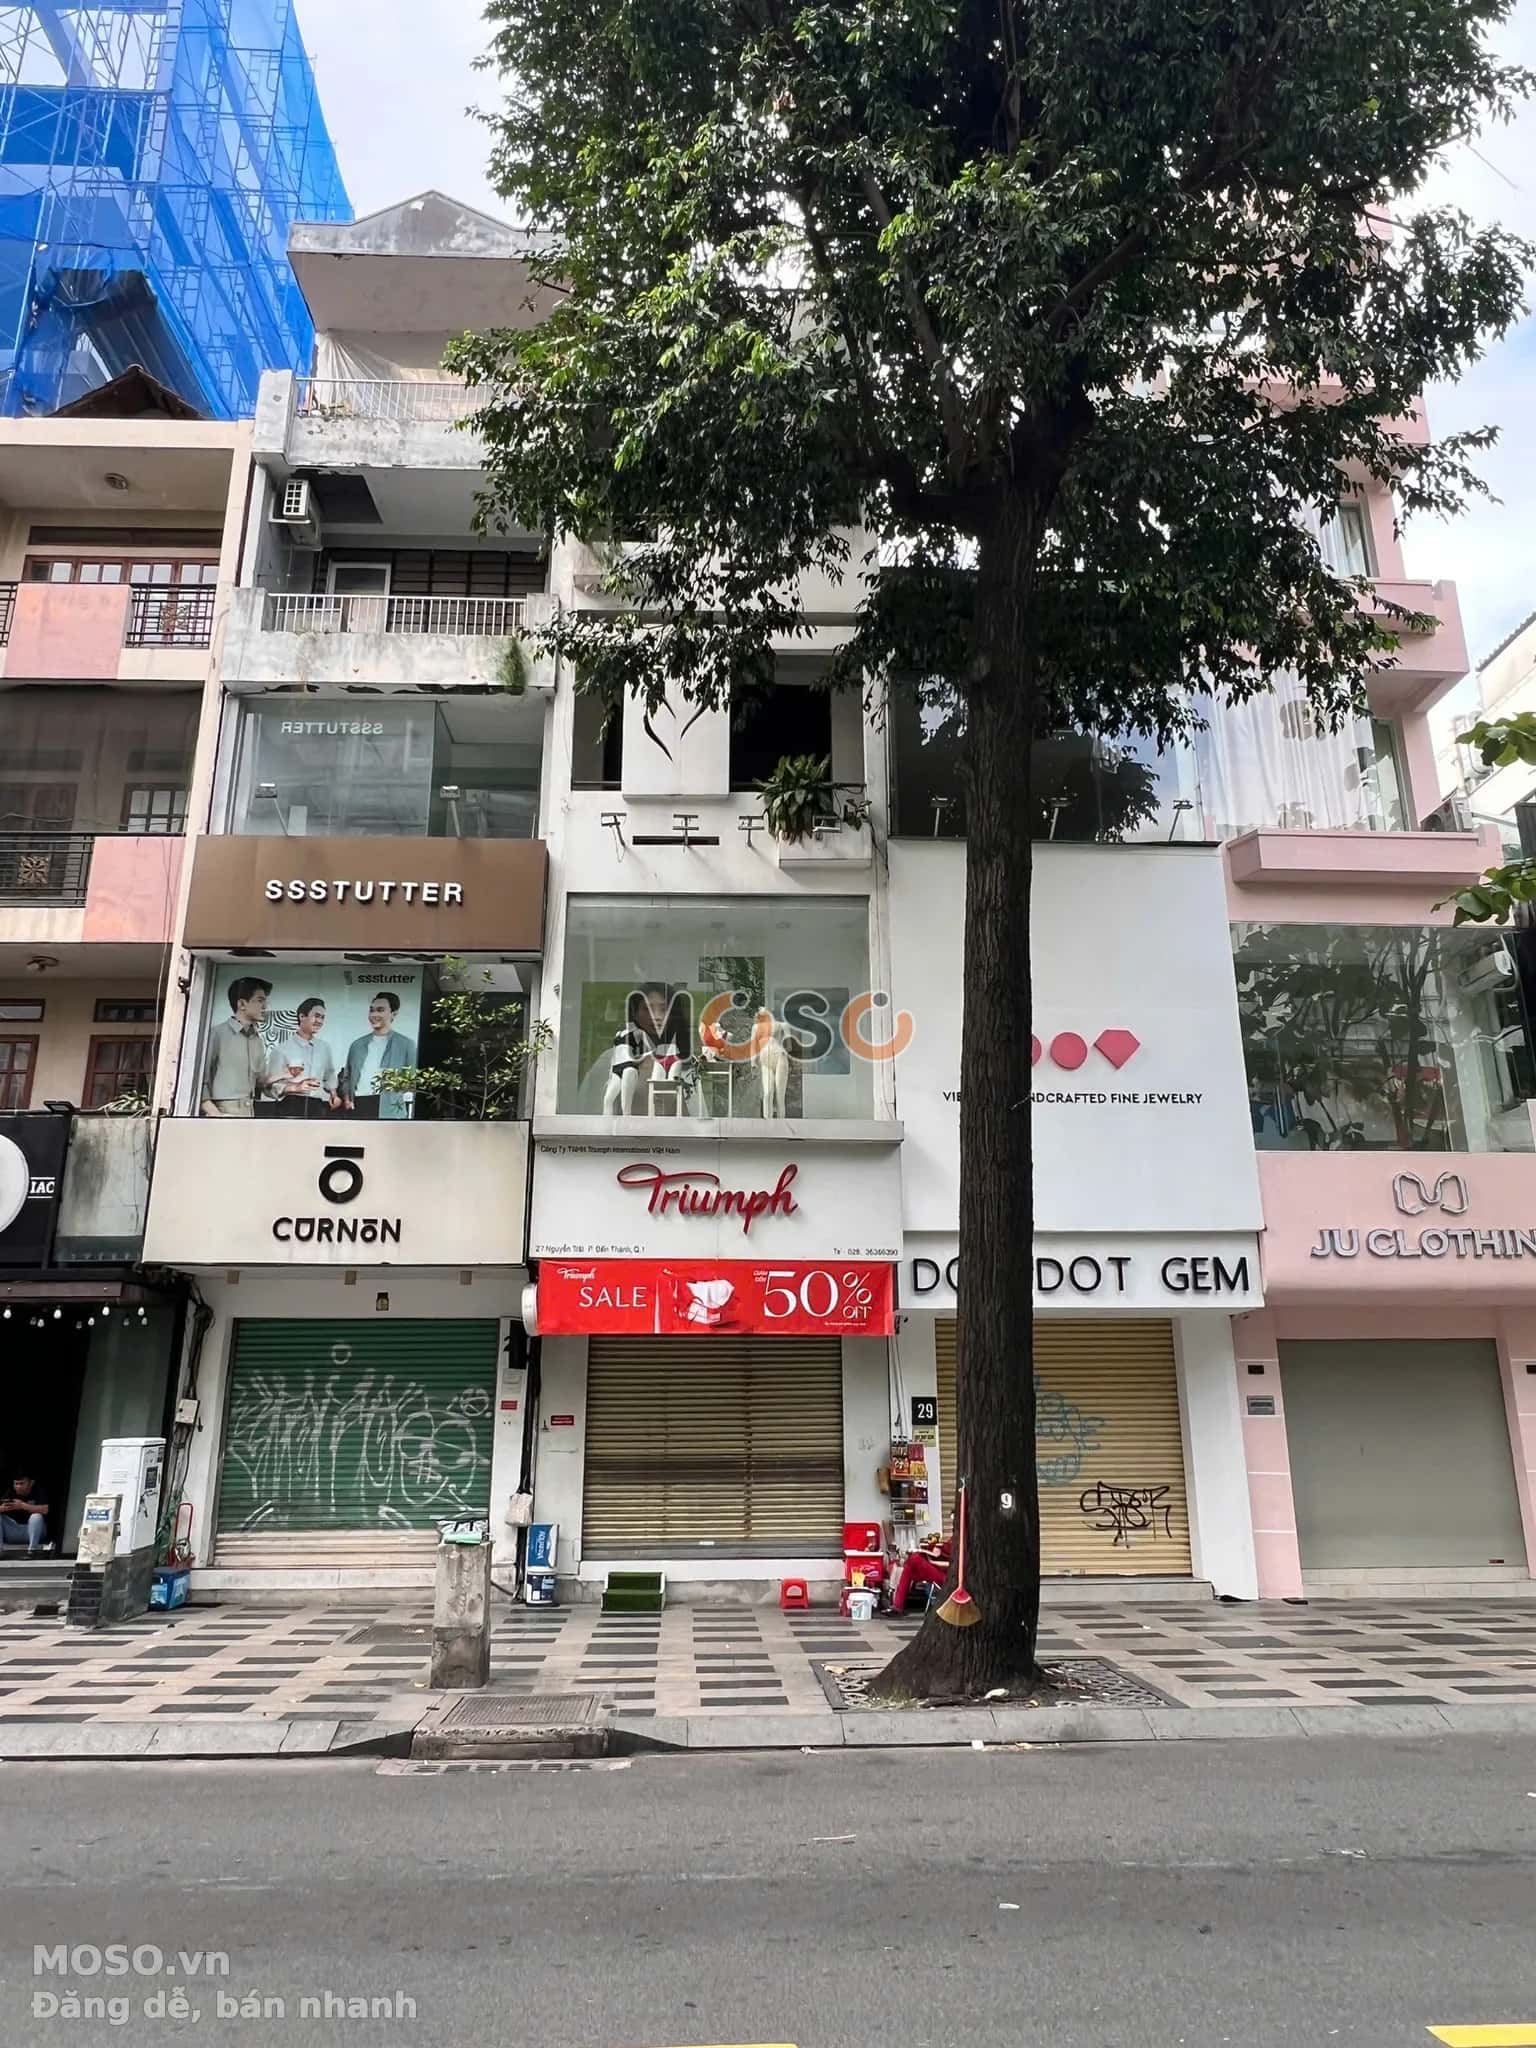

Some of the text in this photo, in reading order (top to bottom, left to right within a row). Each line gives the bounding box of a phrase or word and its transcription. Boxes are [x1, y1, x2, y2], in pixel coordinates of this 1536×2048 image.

[265, 879, 463, 904] SSSTUTTER
[357, 974, 415, 985] ssstutter
[1110, 1093, 1140, 1104] FINE
[1143, 1093, 1203, 1105] JEWELRY
[617, 1164, 799, 1235] Triumph
[1311, 1228, 1360, 1258] JU
[1036, 1256, 1131, 1293] DOT
[1161, 1256, 1249, 1293] GEM
[579, 1287, 647, 1308] SALE
[763, 1270, 872, 1318] 50%
[918, 1403, 933, 1419] 29
[1001, 1493, 1012, 1509] 9
